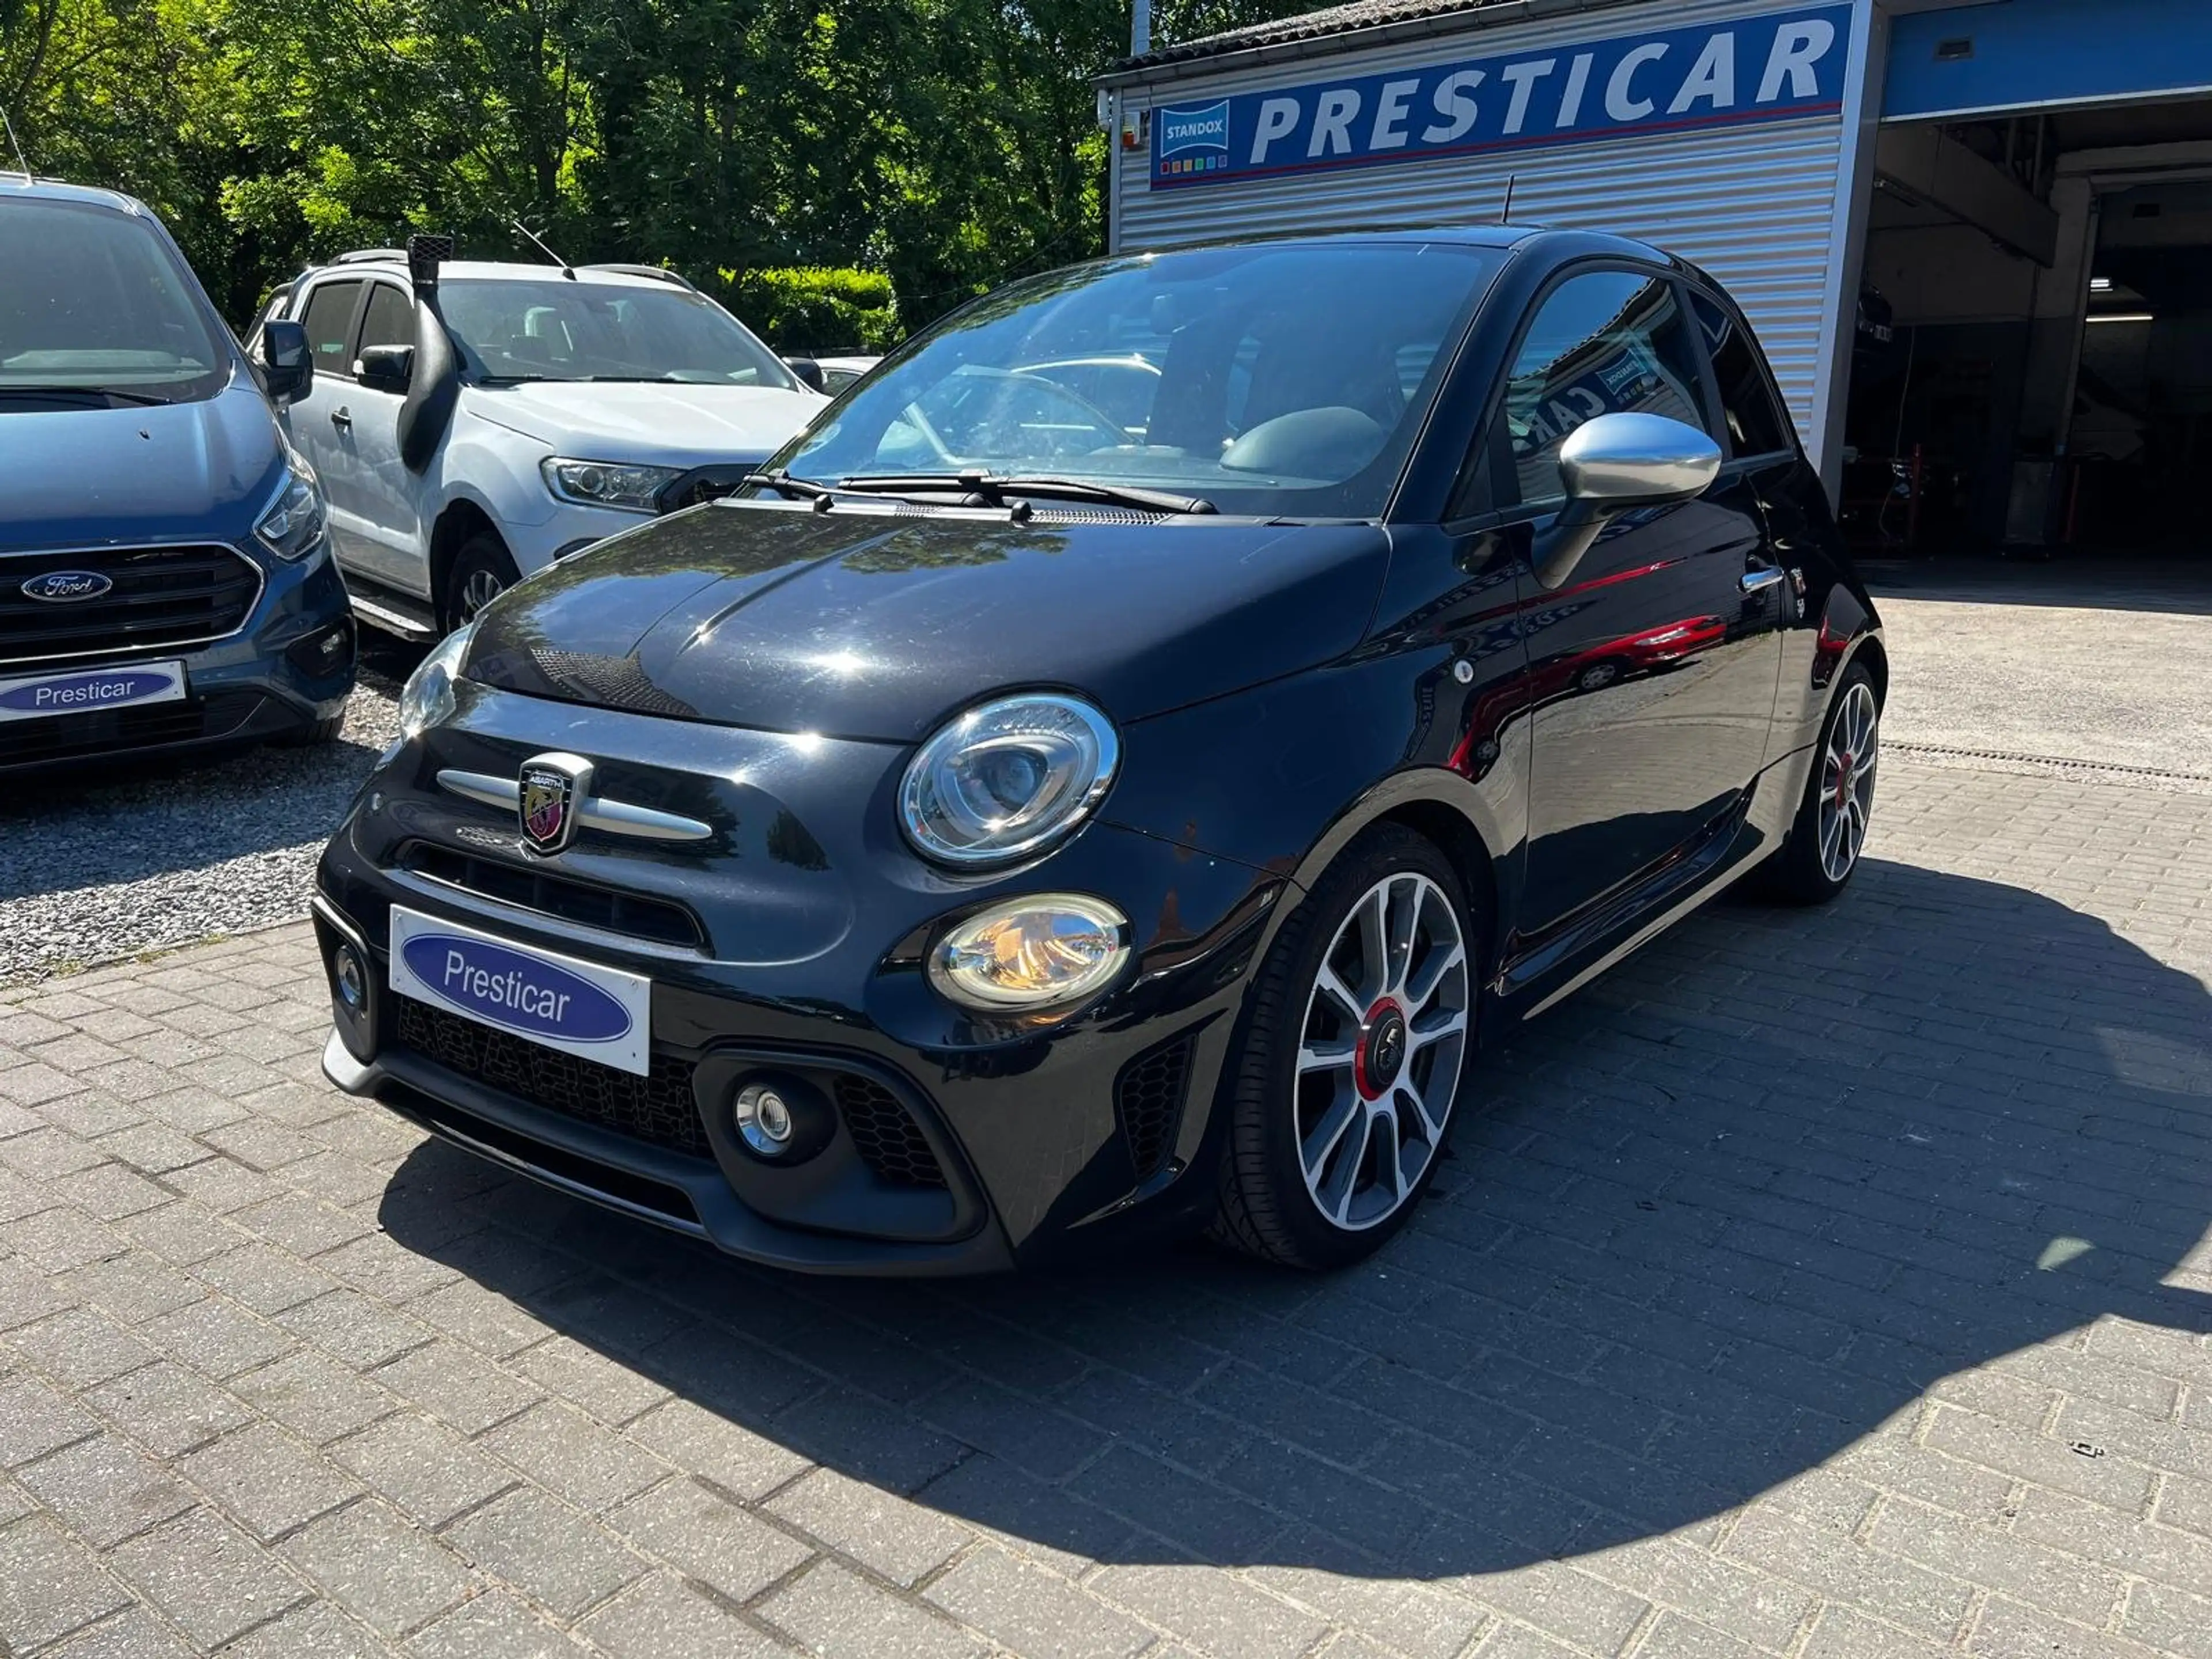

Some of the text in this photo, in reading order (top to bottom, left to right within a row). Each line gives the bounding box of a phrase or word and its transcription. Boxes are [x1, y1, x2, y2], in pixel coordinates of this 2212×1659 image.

[1249, 19, 1835, 164] PRESTICAR
[1167, 119, 1222, 139] STANDOX
[44, 576, 92, 596] Ford
[36, 680, 135, 706] Presticar
[529, 775, 561, 788] ABARTH
[444, 950, 570, 1022] Presticar
